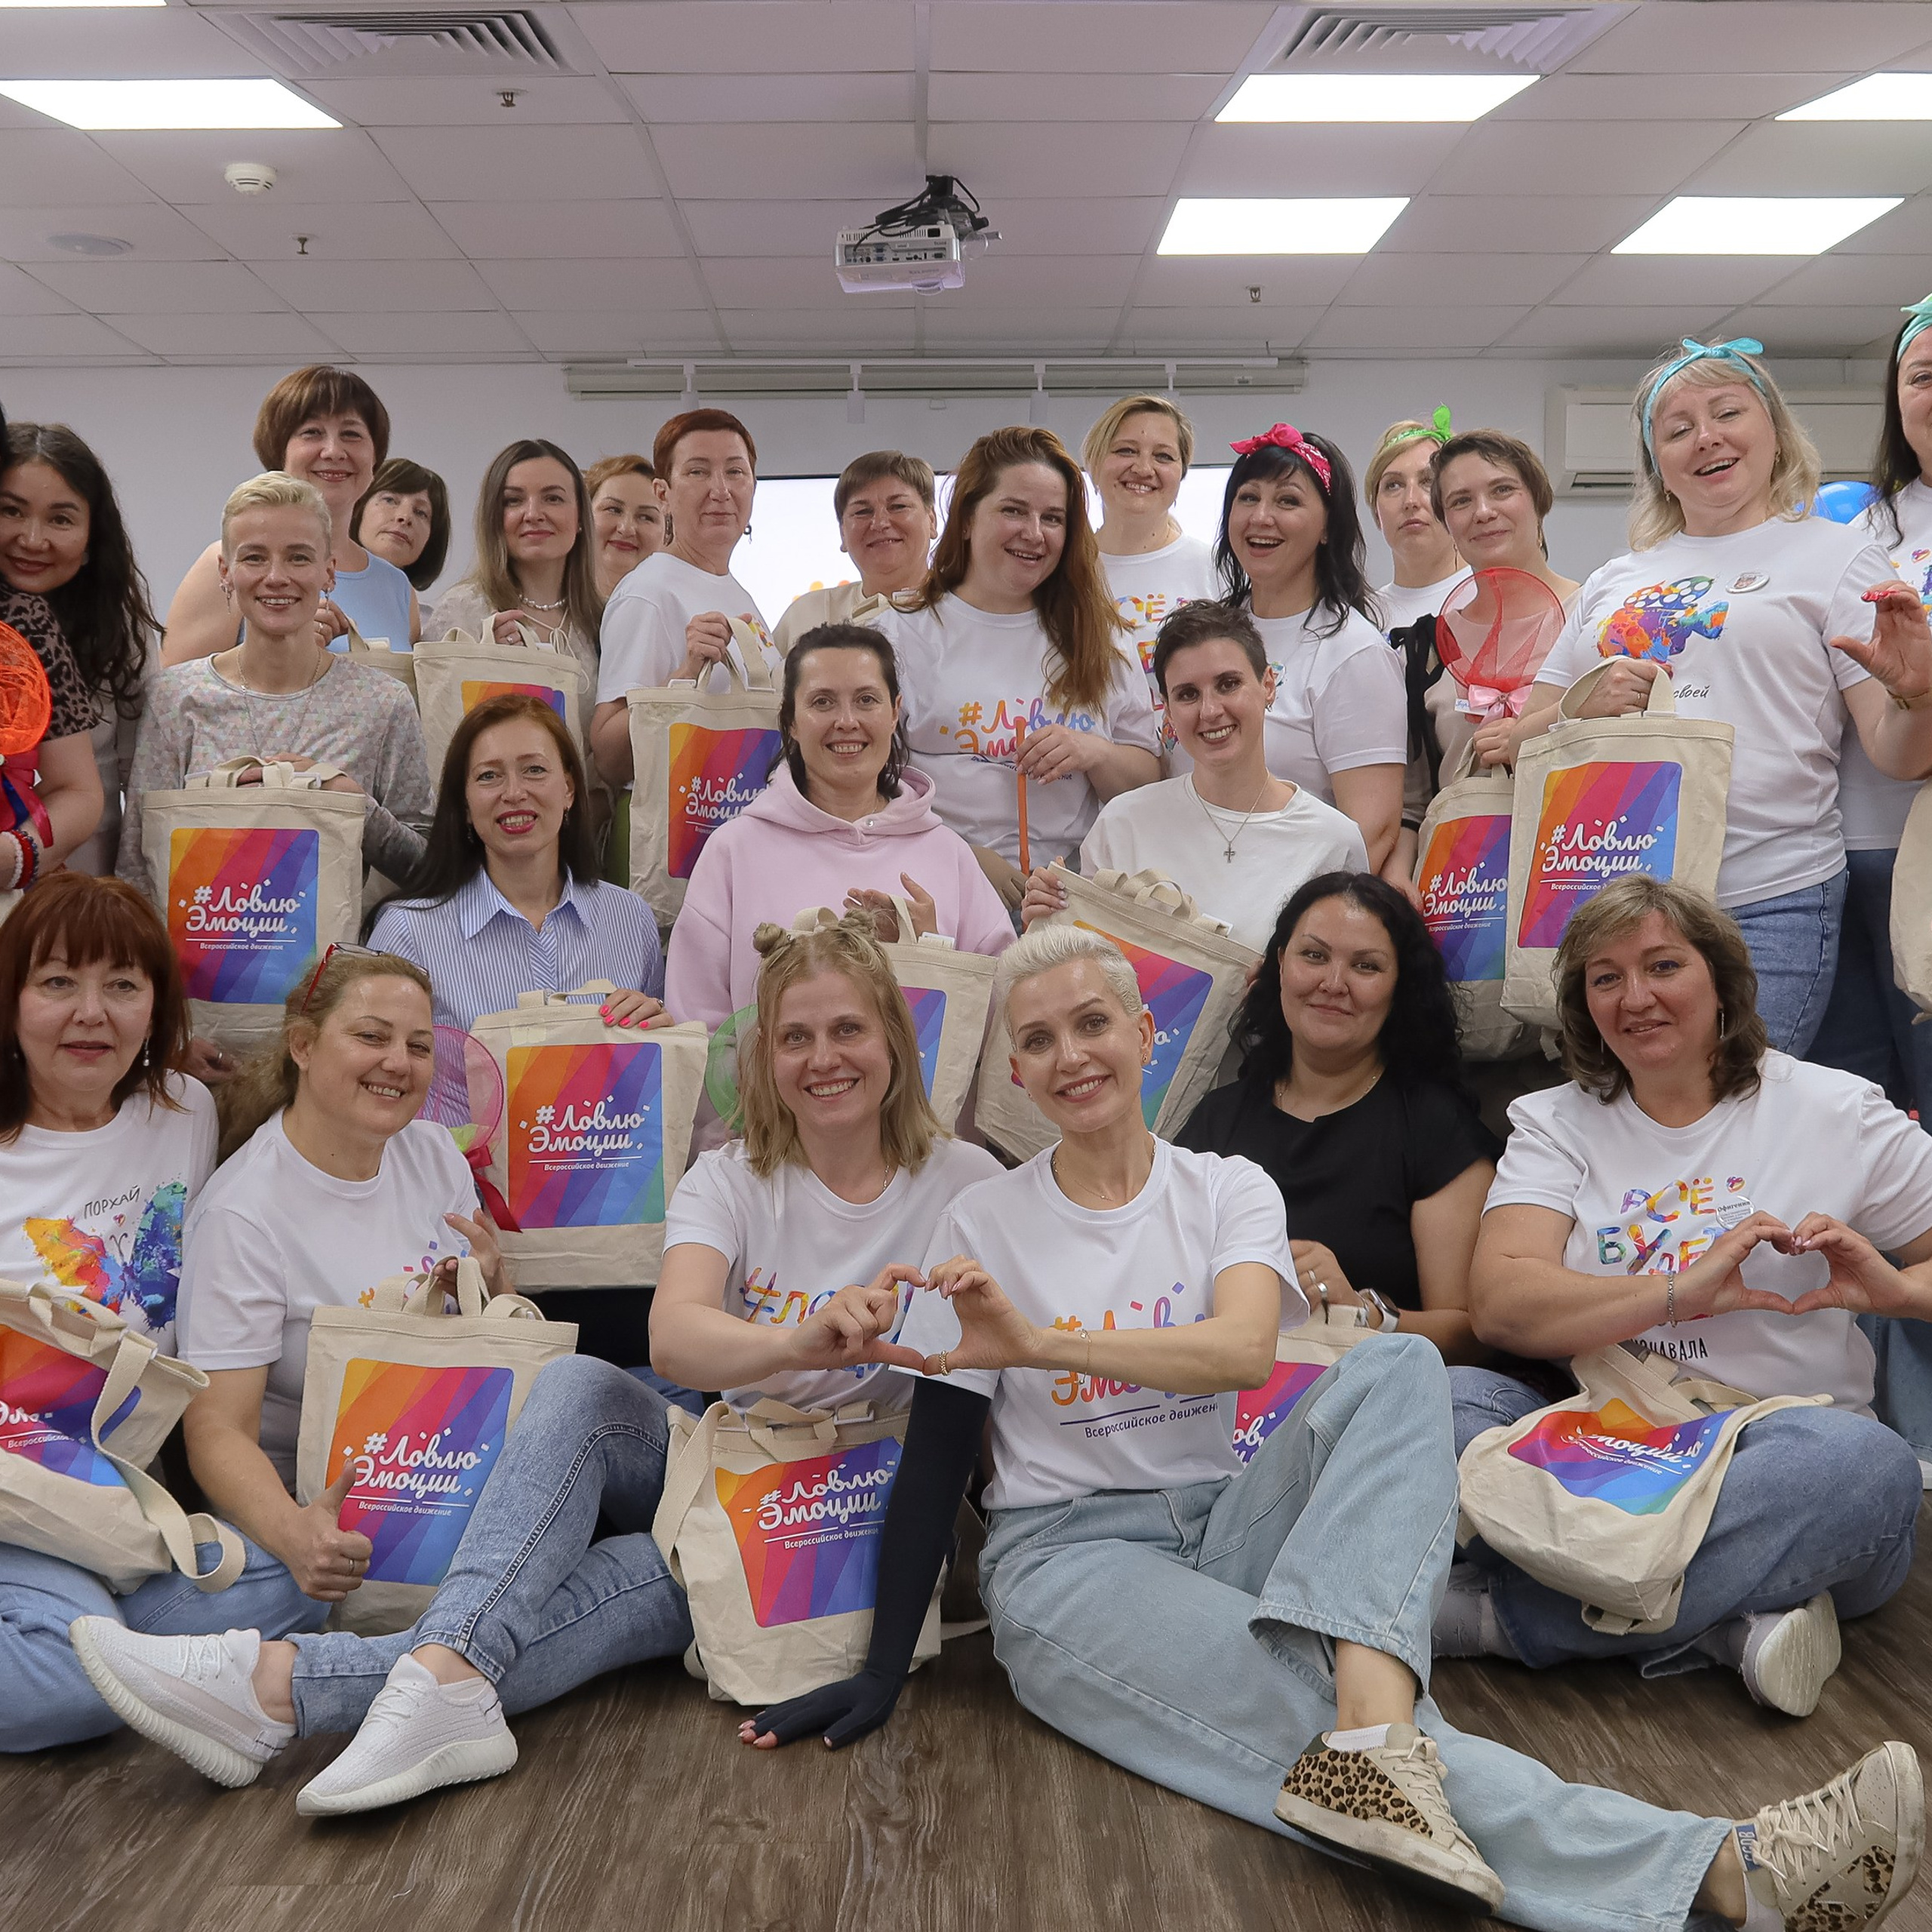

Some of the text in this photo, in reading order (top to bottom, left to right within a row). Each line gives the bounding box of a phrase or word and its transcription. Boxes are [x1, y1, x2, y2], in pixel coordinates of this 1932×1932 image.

[1673, 683, 1711, 699] своей
[1551, 820, 1658, 851] #Ловлю
[1541, 844, 1644, 878] Эмоции
[1429, 866, 1509, 897] #Ловлю
[1550, 882, 1601, 891] Всероссийское
[192, 884, 301, 913] #Ловлю
[1423, 893, 1497, 918] Эмоции
[185, 905, 288, 939] Эмоции
[535, 1100, 645, 1132] #Ловлю
[528, 1125, 634, 1157] Эмоции
[543, 1163, 595, 1172] Всероссийское
[84, 1185, 141, 1219] ПОРХАЙ
[1084, 1414, 1167, 1438] Всероссийское
[363, 1432, 482, 1470] #Ловлю
[353, 1455, 462, 1500] Эмоции
[759, 1469, 894, 1506] #Ловлю
[358, 1500, 453, 1517] Всероссийское движение
[756, 1492, 881, 1531] Эмоции
[783, 1532, 843, 1549] Всероссийское
